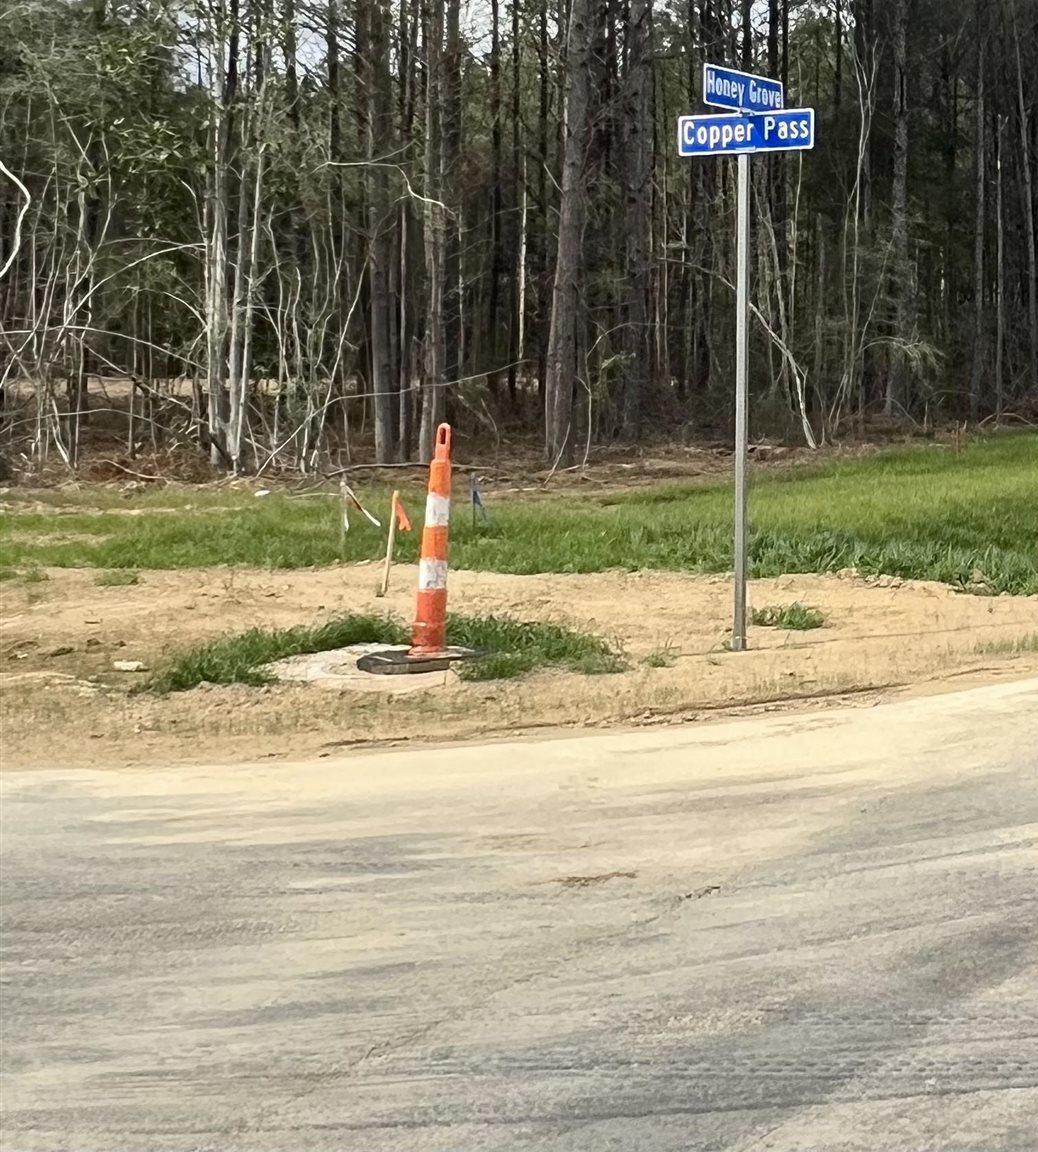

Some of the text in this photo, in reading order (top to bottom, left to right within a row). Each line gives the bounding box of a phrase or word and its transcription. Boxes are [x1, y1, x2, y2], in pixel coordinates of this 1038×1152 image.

[707, 71, 782, 108] Honey Grove
[683, 115, 809, 149] Copper Pass
